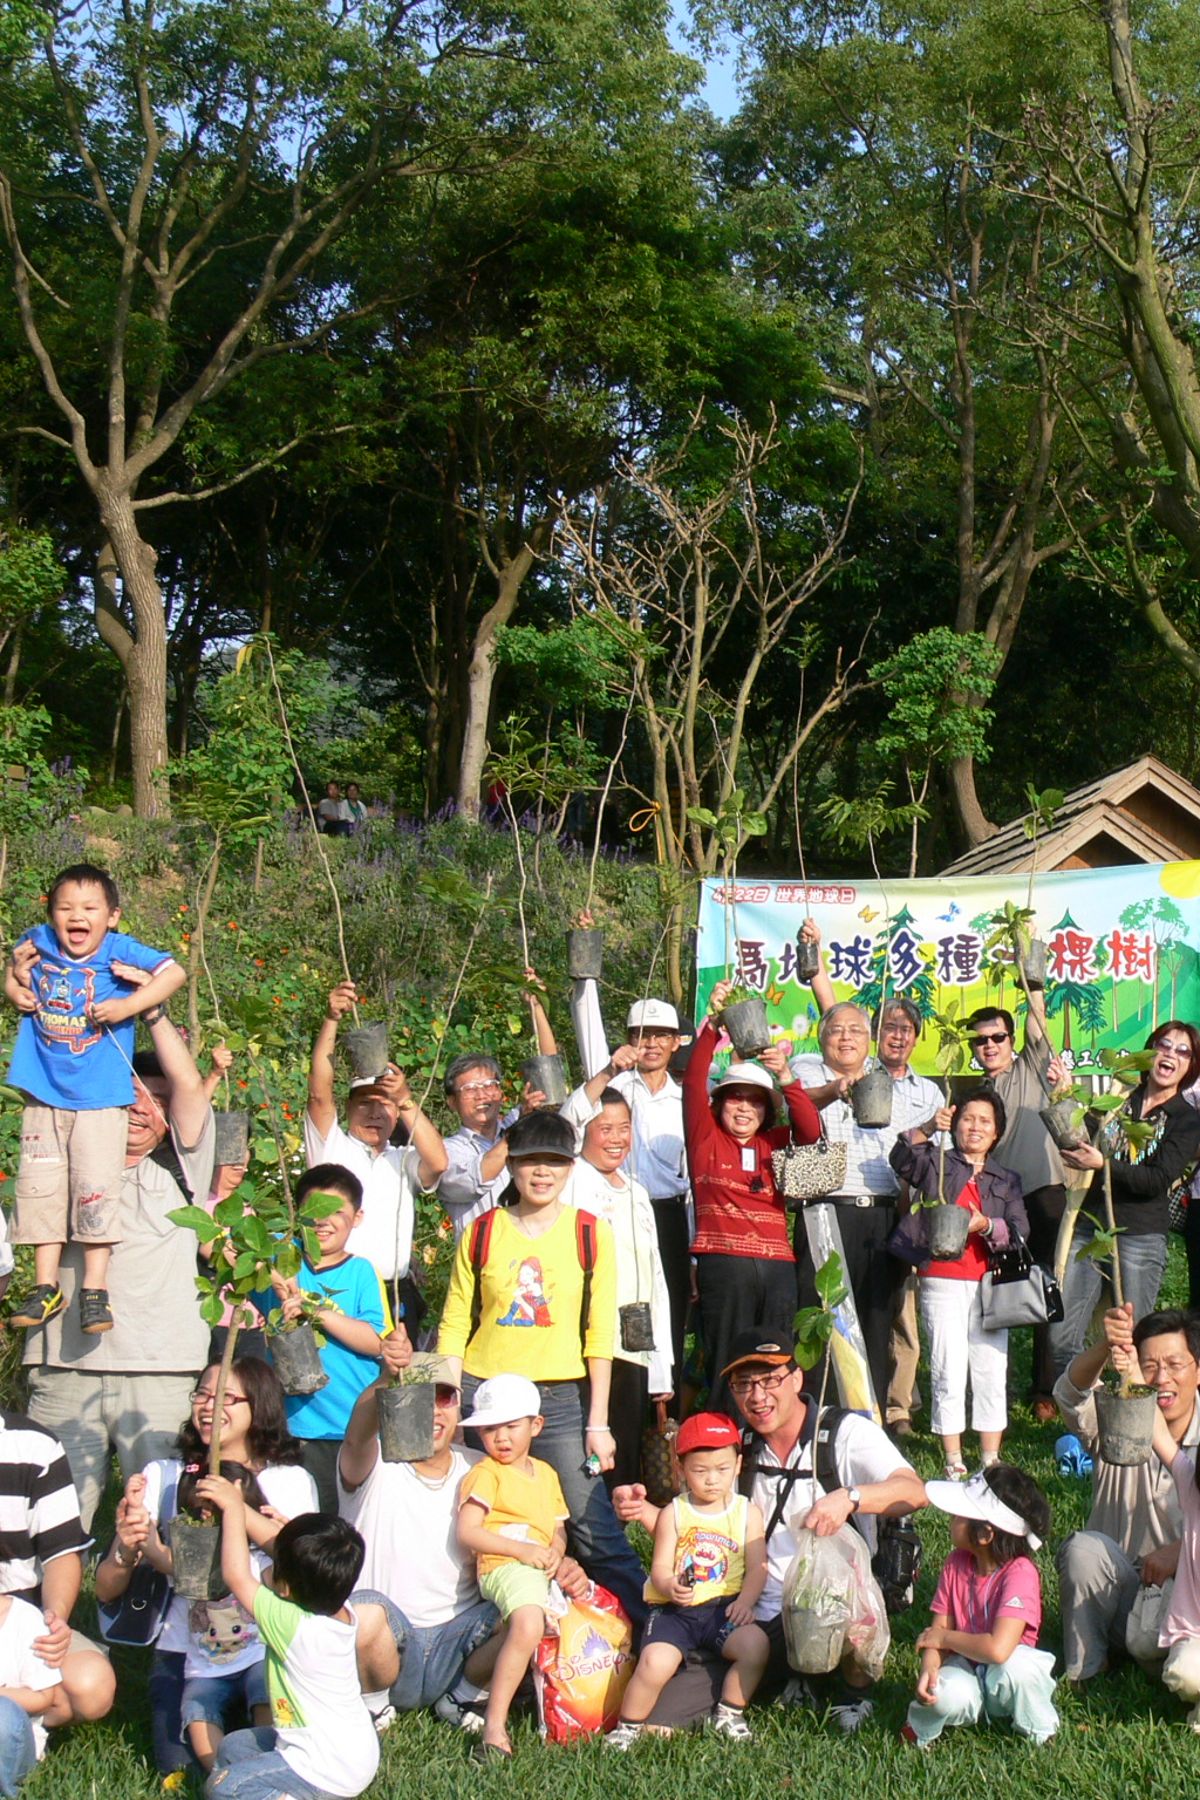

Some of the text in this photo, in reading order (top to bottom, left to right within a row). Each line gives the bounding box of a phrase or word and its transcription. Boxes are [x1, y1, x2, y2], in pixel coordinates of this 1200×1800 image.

[776, 886, 855, 903] 世界地球日
[40, 1011, 87, 1028] THOMAS
